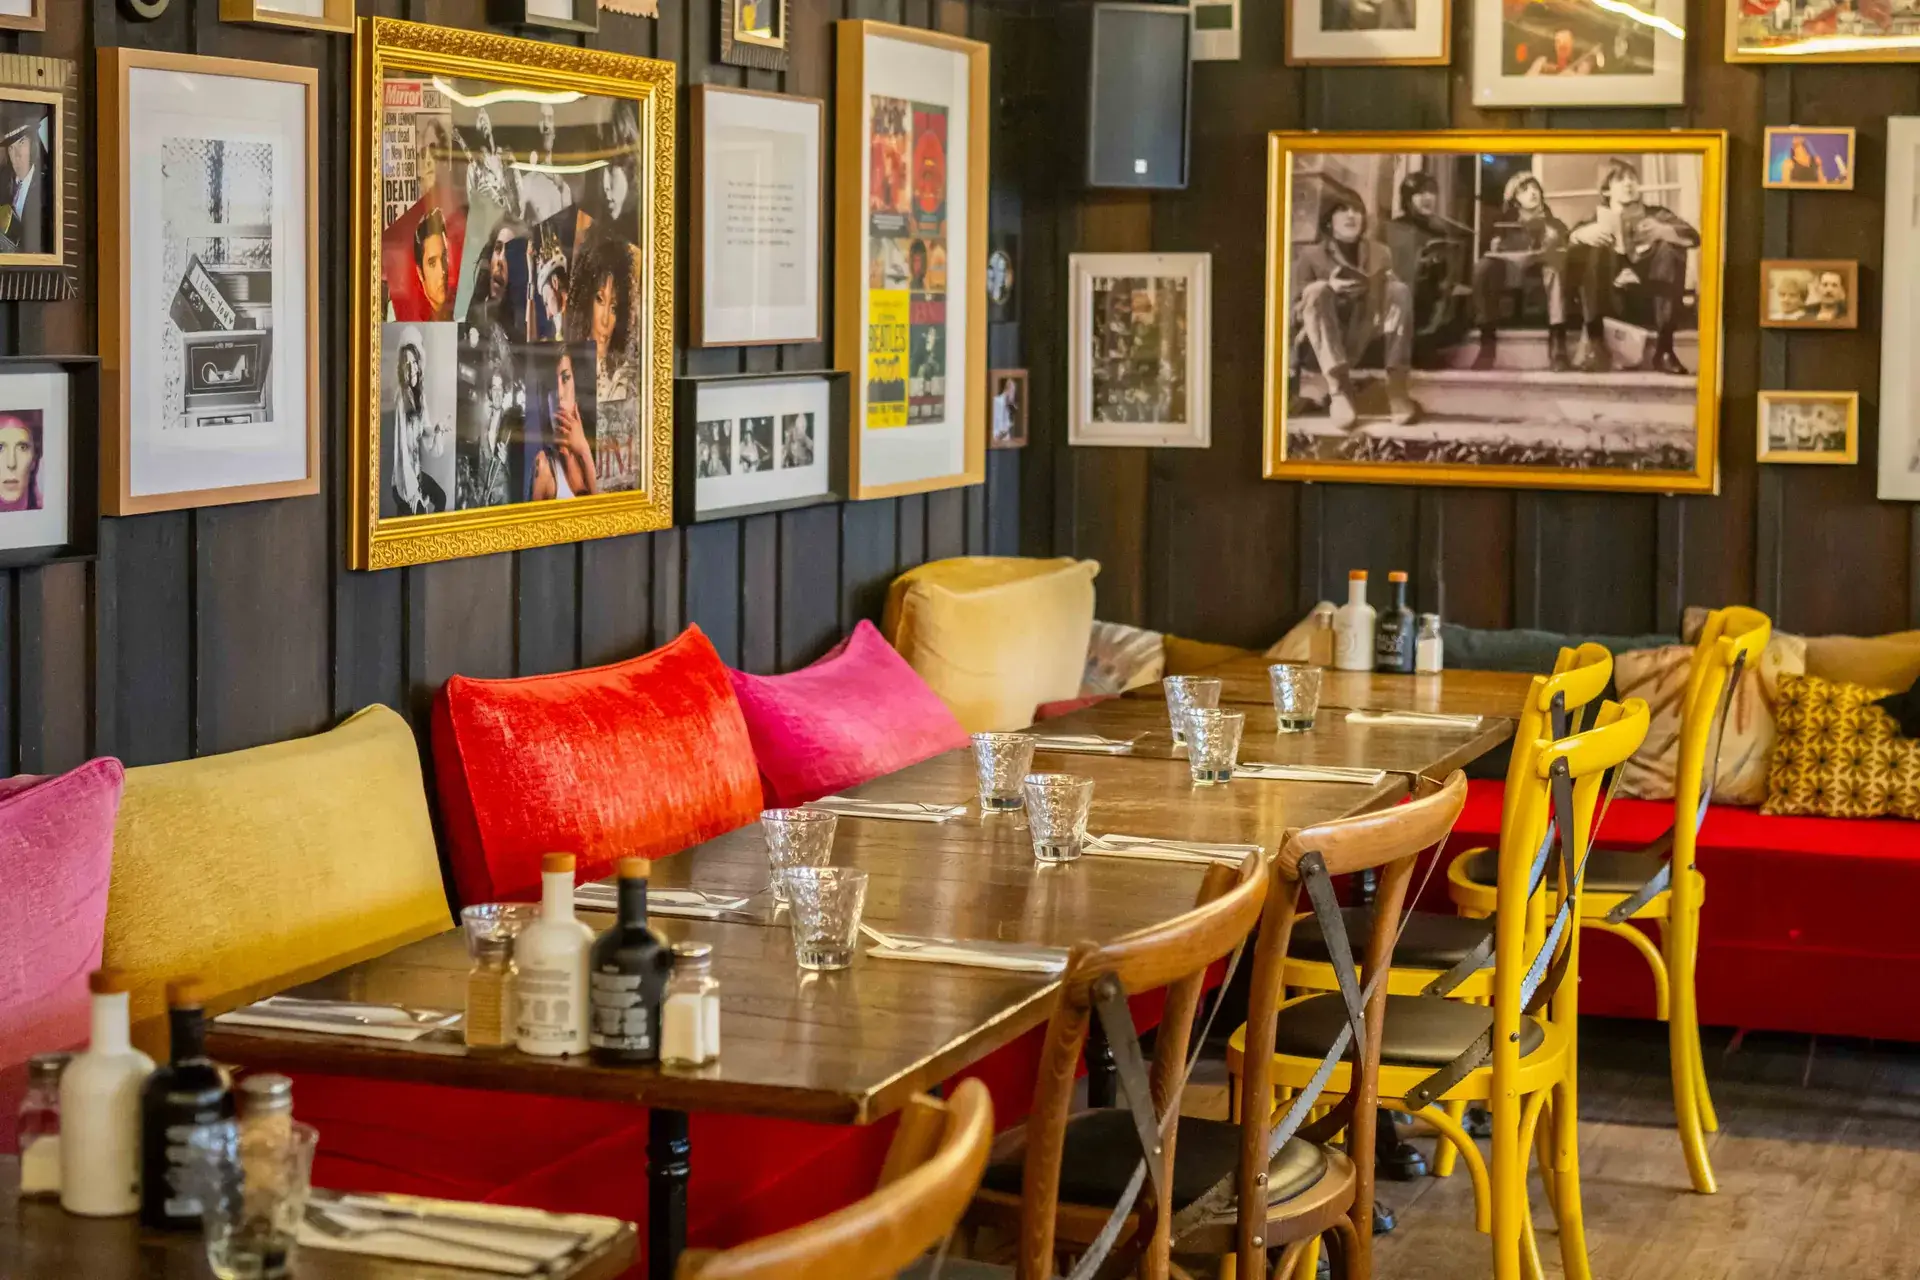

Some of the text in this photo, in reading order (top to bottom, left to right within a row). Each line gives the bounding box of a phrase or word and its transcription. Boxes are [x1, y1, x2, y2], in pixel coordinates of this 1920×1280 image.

[386, 83, 421, 105] Mirror
[397, 127, 410, 143] dead
[404, 145, 416, 160] York
[386, 179, 417, 202] DEATH
[200, 280, 217, 304] LOVE
